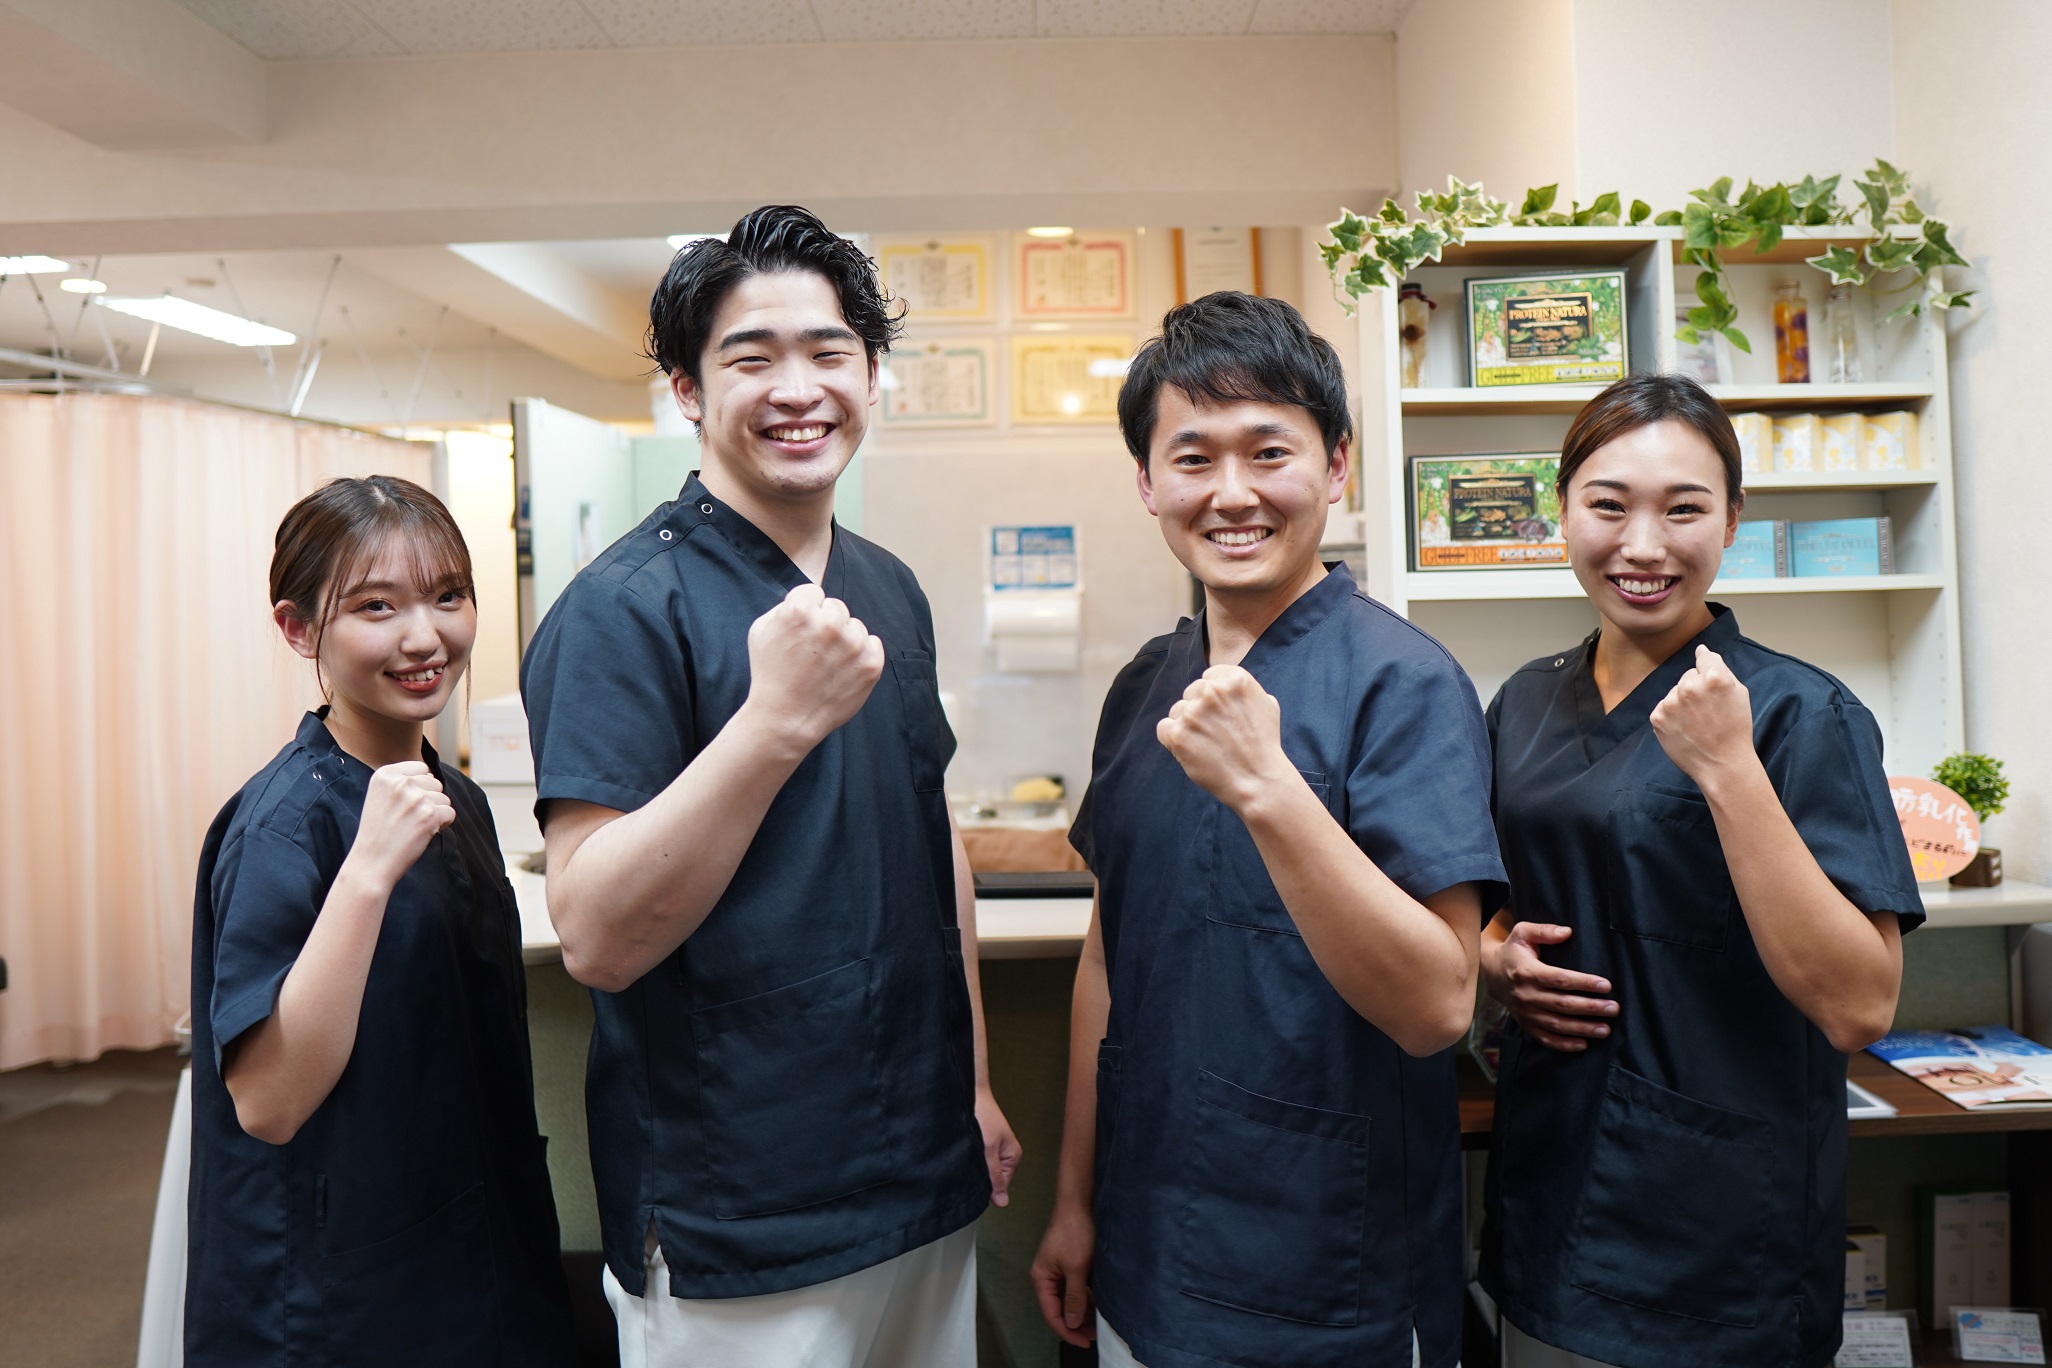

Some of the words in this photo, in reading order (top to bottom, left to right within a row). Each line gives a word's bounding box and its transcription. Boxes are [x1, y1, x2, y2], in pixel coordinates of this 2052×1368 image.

[1509, 307, 1550, 320] PROTEIN
[1550, 305, 1588, 318] NATURA
[1454, 487, 1494, 499] PROTEIN
[1496, 486, 1532, 498] NATURA
